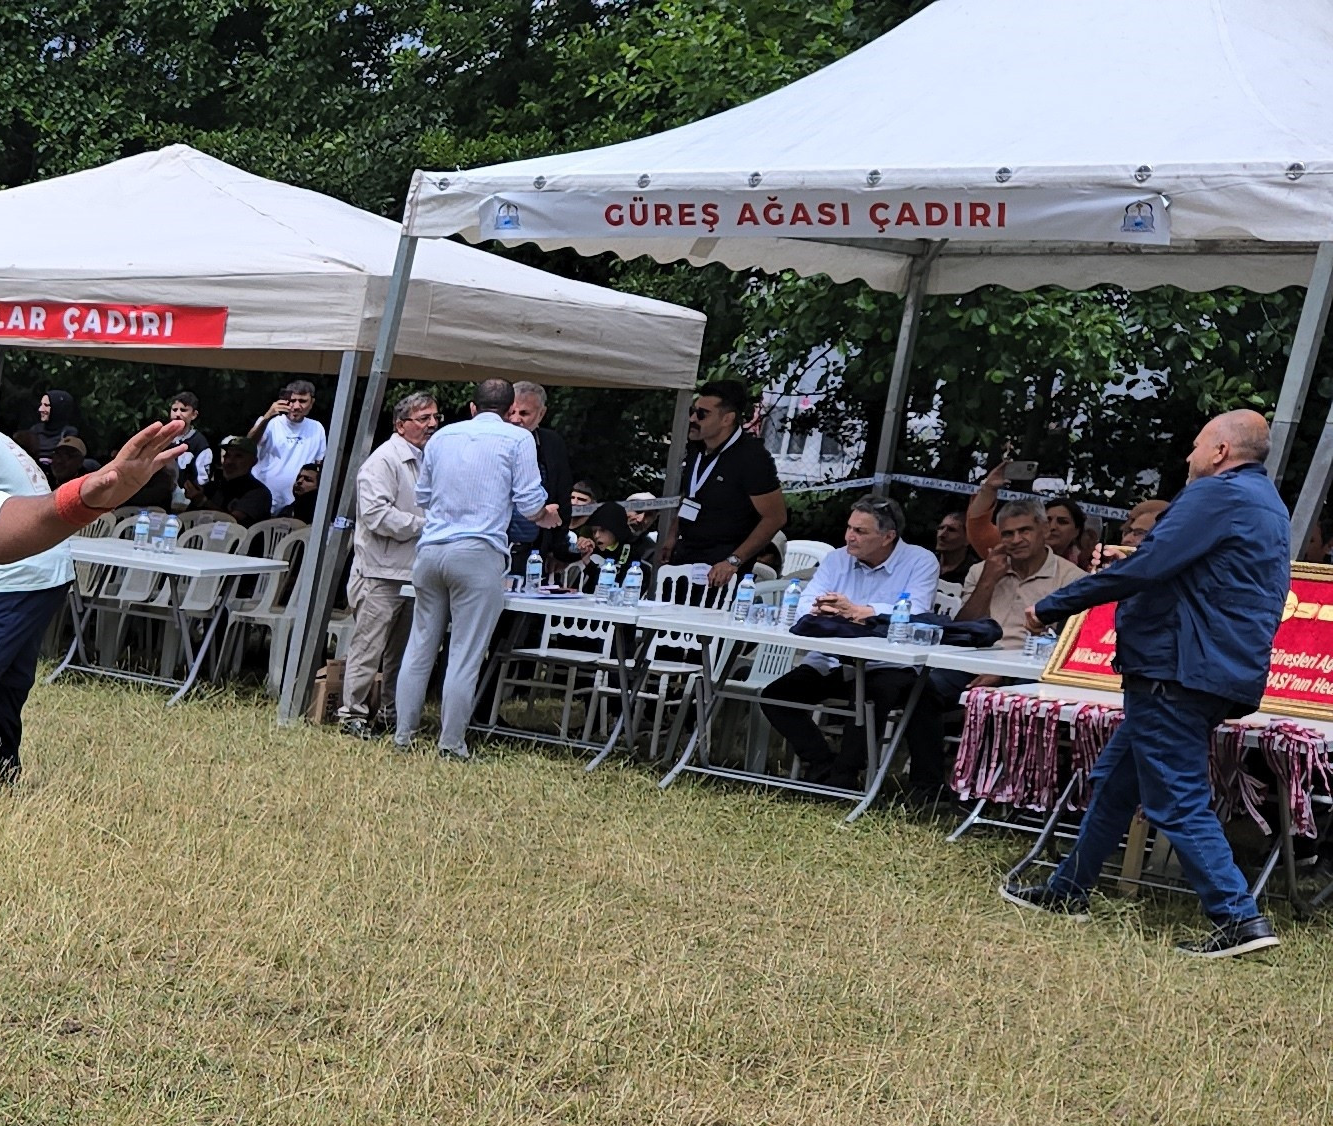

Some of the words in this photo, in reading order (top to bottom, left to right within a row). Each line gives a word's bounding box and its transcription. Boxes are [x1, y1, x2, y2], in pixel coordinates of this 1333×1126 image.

[603, 195, 721, 234] GÜREŞ
[736, 194, 852, 228] AĞASI
[868, 200, 1008, 234] ÇADIRI
[62, 307, 175, 340] ÇADIRI
[1069, 647, 1108, 666] Niksar
